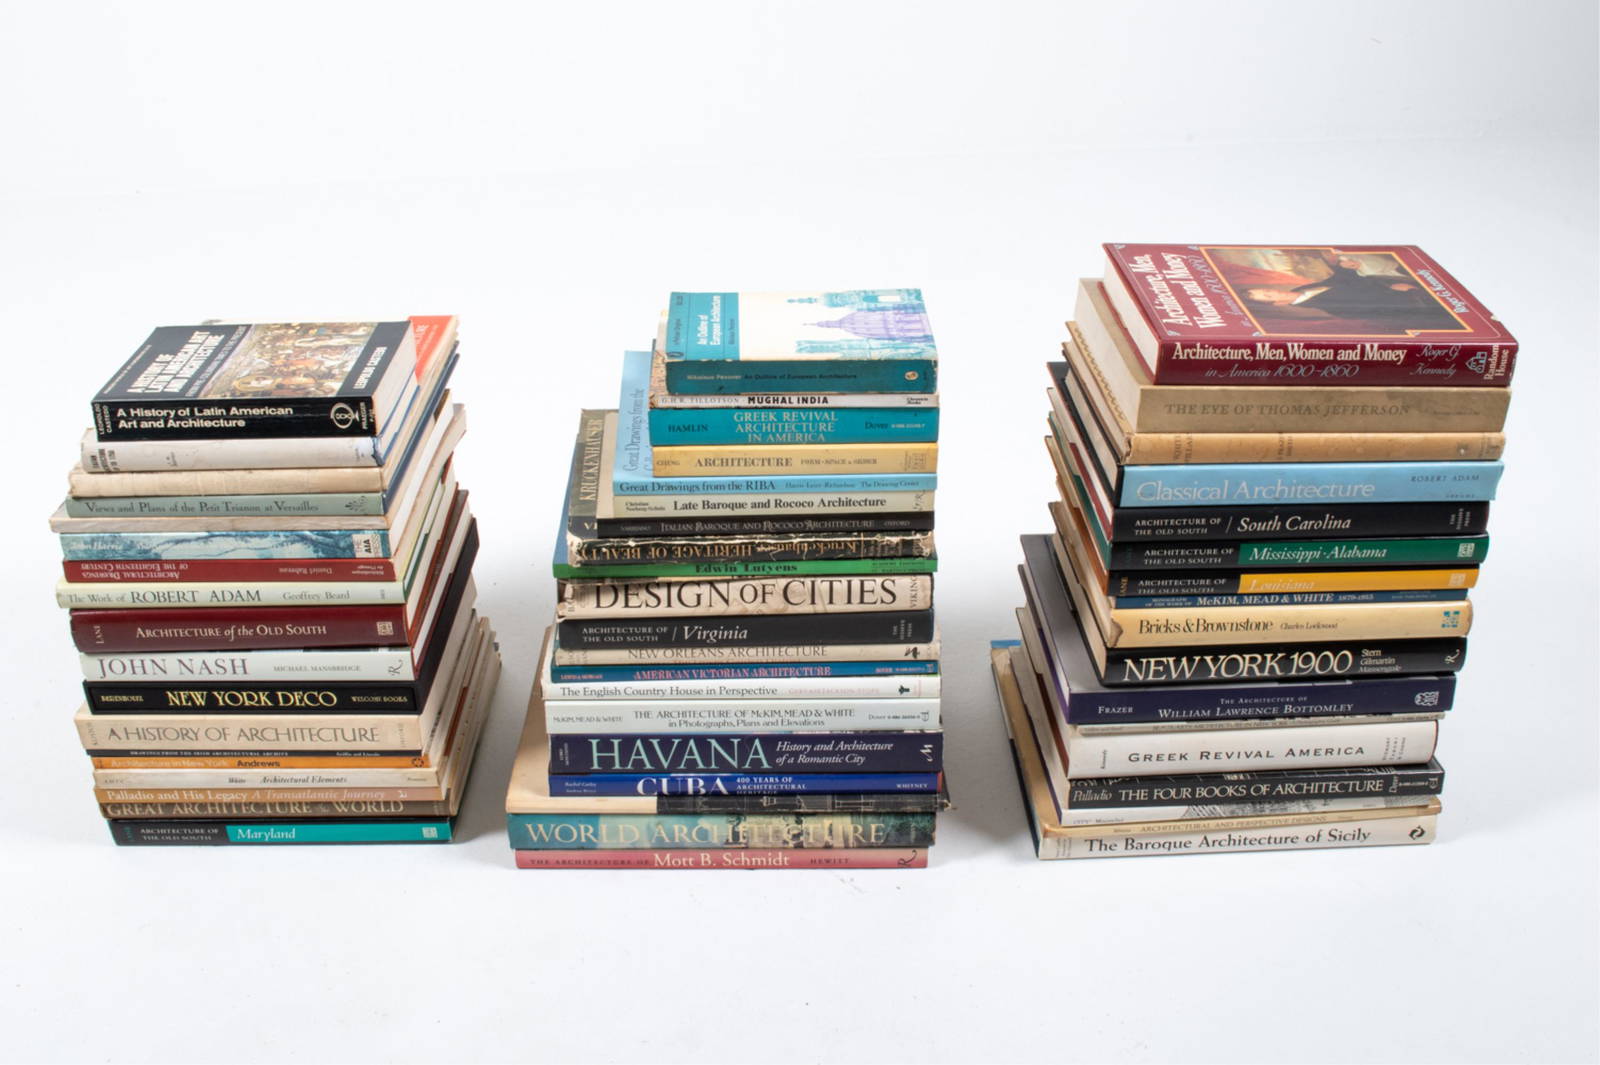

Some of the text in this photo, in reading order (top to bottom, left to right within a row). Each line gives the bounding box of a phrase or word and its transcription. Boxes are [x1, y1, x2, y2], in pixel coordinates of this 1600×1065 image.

[1172, 342, 1407, 364] Architecture, Men, Women and Money
[1484, 344, 1499, 380] Random
[1495, 349, 1509, 376] House
[748, 396, 828, 404] MUGHAL INDIA
[117, 405, 293, 419] A History of Latin American
[734, 412, 838, 422] GREEK REVIVAL
[1166, 404, 1410, 416] THE EYE OF THOMAS JEFFERSON
[103, 405, 112, 432] CASTEDO
[118, 418, 246, 428] Art and Architecture
[668, 424, 708, 432] HAMLIN
[736, 422, 834, 433] ARCHITECTURE
[749, 432, 824, 442] IN AMERICA
[580, 420, 604, 500] KRUCKENHAUSER
[695, 458, 792, 468] ARCHITECTURE
[620, 482, 648, 492] Great
[652, 482, 698, 494] Drawings
[702, 481, 728, 491] from
[730, 481, 742, 490] the
[746, 481, 776, 490] RIBA
[1137, 479, 1376, 501] Classical Architecture
[674, 497, 886, 512] Late Baroque and Rococo Architecture
[1135, 518, 1206, 526] ARCHITECTURE
[1237, 514, 1352, 532] South Carolina
[1135, 528, 1151, 536] THE
[363, 540, 372, 553] AIA
[1144, 549, 1218, 557] ARCHITECTURE
[695, 562, 797, 574] Edwin Lutyens
[130, 590, 262, 604] ROBERT ADAM
[596, 578, 897, 608] DESIGN OF CITIES
[136, 624, 327, 641] ARCHITECTURE of the OLD SOUTH
[1139, 617, 1274, 634] Bricks & Brownstone
[683, 626, 748, 643] Virginia
[1362, 649, 1382, 657] Stern
[97, 658, 249, 678] JOHN NASH
[1123, 650, 1352, 681] NEW YORK 1900
[1360, 657, 1395, 665] Gilmartin
[166, 691, 338, 706] NEW YORK DECO
[560, 686, 580, 696] The
[583, 686, 620, 698] English
[624, 686, 666, 698] Country
[670, 686, 704, 696] House
[706, 686, 716, 695] in
[718, 685, 778, 698] Perspective
[634, 711, 652, 719] THE
[657, 710, 730, 719] ARCHITECTURE
[734, 710, 748, 718] OF
[784, 710, 812, 718] MEAD
[824, 709, 854, 718] WHITE
[1098, 706, 1134, 714] FRAZER
[1158, 704, 1354, 718] WILLIAM LAWRENCE BOTTOMLEY
[668, 720, 676, 728] in
[678, 720, 735, 730] Photographs,
[781, 718, 824, 726] Elevations
[108, 728, 122, 740] A
[125, 727, 200, 741] HISTORY
[205, 727, 231, 741] OF
[237, 727, 380, 742] ARCHITECTURE
[588, 737, 772, 770] HAVANA
[776, 740, 894, 753] History and Architecture
[776, 754, 866, 766] of a Romantic City
[1128, 746, 1364, 762] GREEK REVIVAL AMERICA
[237, 760, 280, 768] Andrews
[636, 777, 728, 796] CUBA
[1073, 780, 1384, 802] Palladio THE FOUR BOOKS OF ARCHITECTURE
[107, 804, 163, 816] GREAT
[173, 802, 312, 816] ARCHITECTURE
[332, 801, 404, 814] WORLD
[236, 828, 296, 842] Maryland
[526, 822, 886, 844] WORLD ARCHITECTURE
[1086, 838, 1118, 852] The
[1124, 836, 1192, 852] Baroque
[1198, 832, 1299, 850] Architecture
[1306, 830, 1322, 843] of
[1328, 828, 1371, 843] Sicily
[653, 854, 694, 867] Mott
[700, 854, 716, 866] B.
[722, 852, 790, 867] Schmidt
